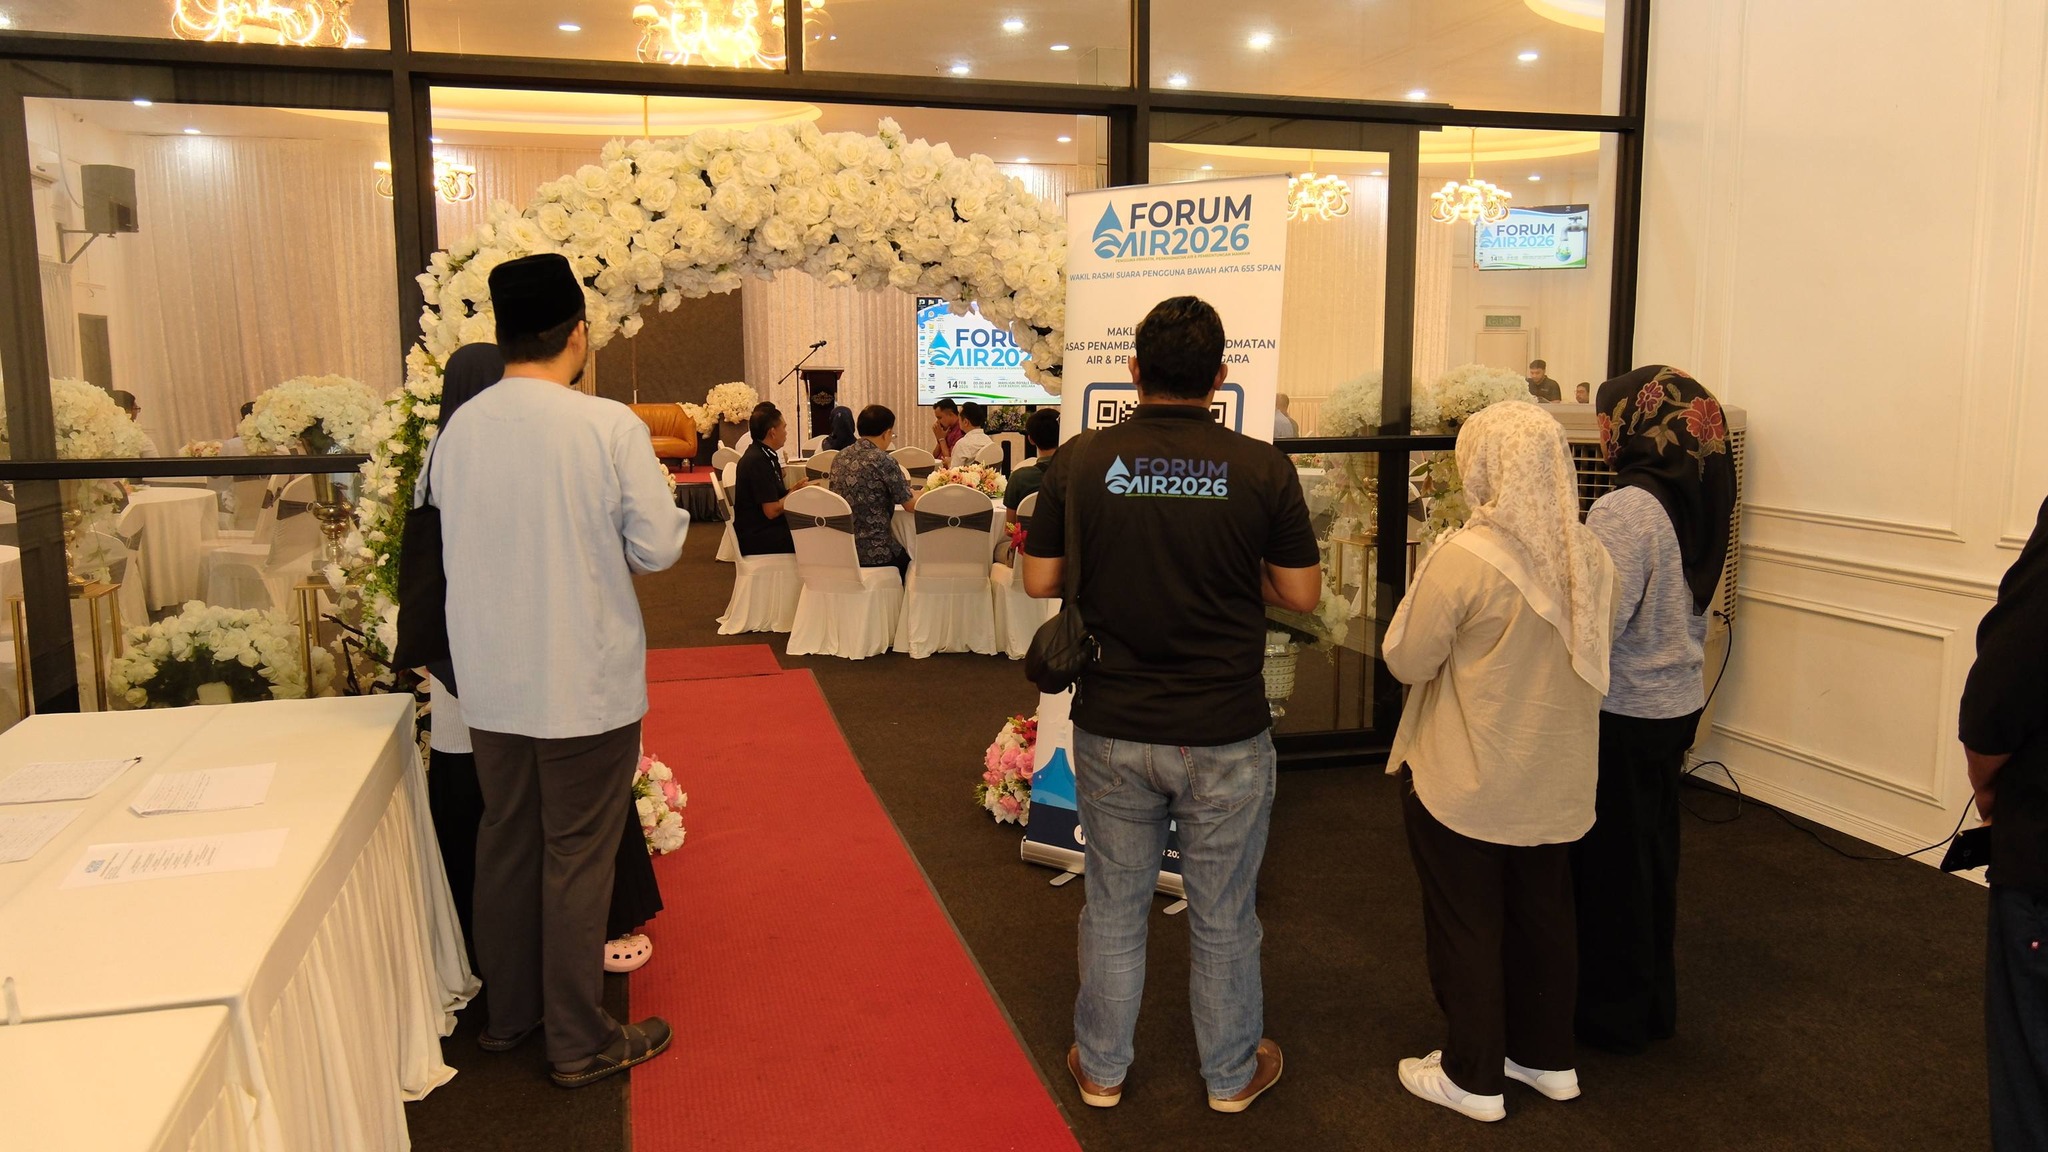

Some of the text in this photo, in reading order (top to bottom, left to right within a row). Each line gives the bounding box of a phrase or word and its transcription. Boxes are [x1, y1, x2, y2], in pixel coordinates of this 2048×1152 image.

[1130, 194, 1252, 229] FORUM
[1496, 223, 1555, 236] FORUM
[1116, 223, 1250, 258] AIR2026
[1069, 264, 1281, 281] WAKIL RASMI SUARA PENGGUNA BAWAH AKTA 655 SPAN
[956, 328, 1019, 348] FORU
[1107, 326, 1135, 336] MAKL
[1065, 338, 1276, 351] ASAS PENAMBA DMATAN
[1086, 355, 1103, 364] AIR
[1105, 355, 1112, 364] &
[1221, 353, 1250, 364] GARA
[947, 380, 958, 389] 14
[1134, 457, 1229, 478] FORUM
[1125, 475, 1228, 497] AIR2026
